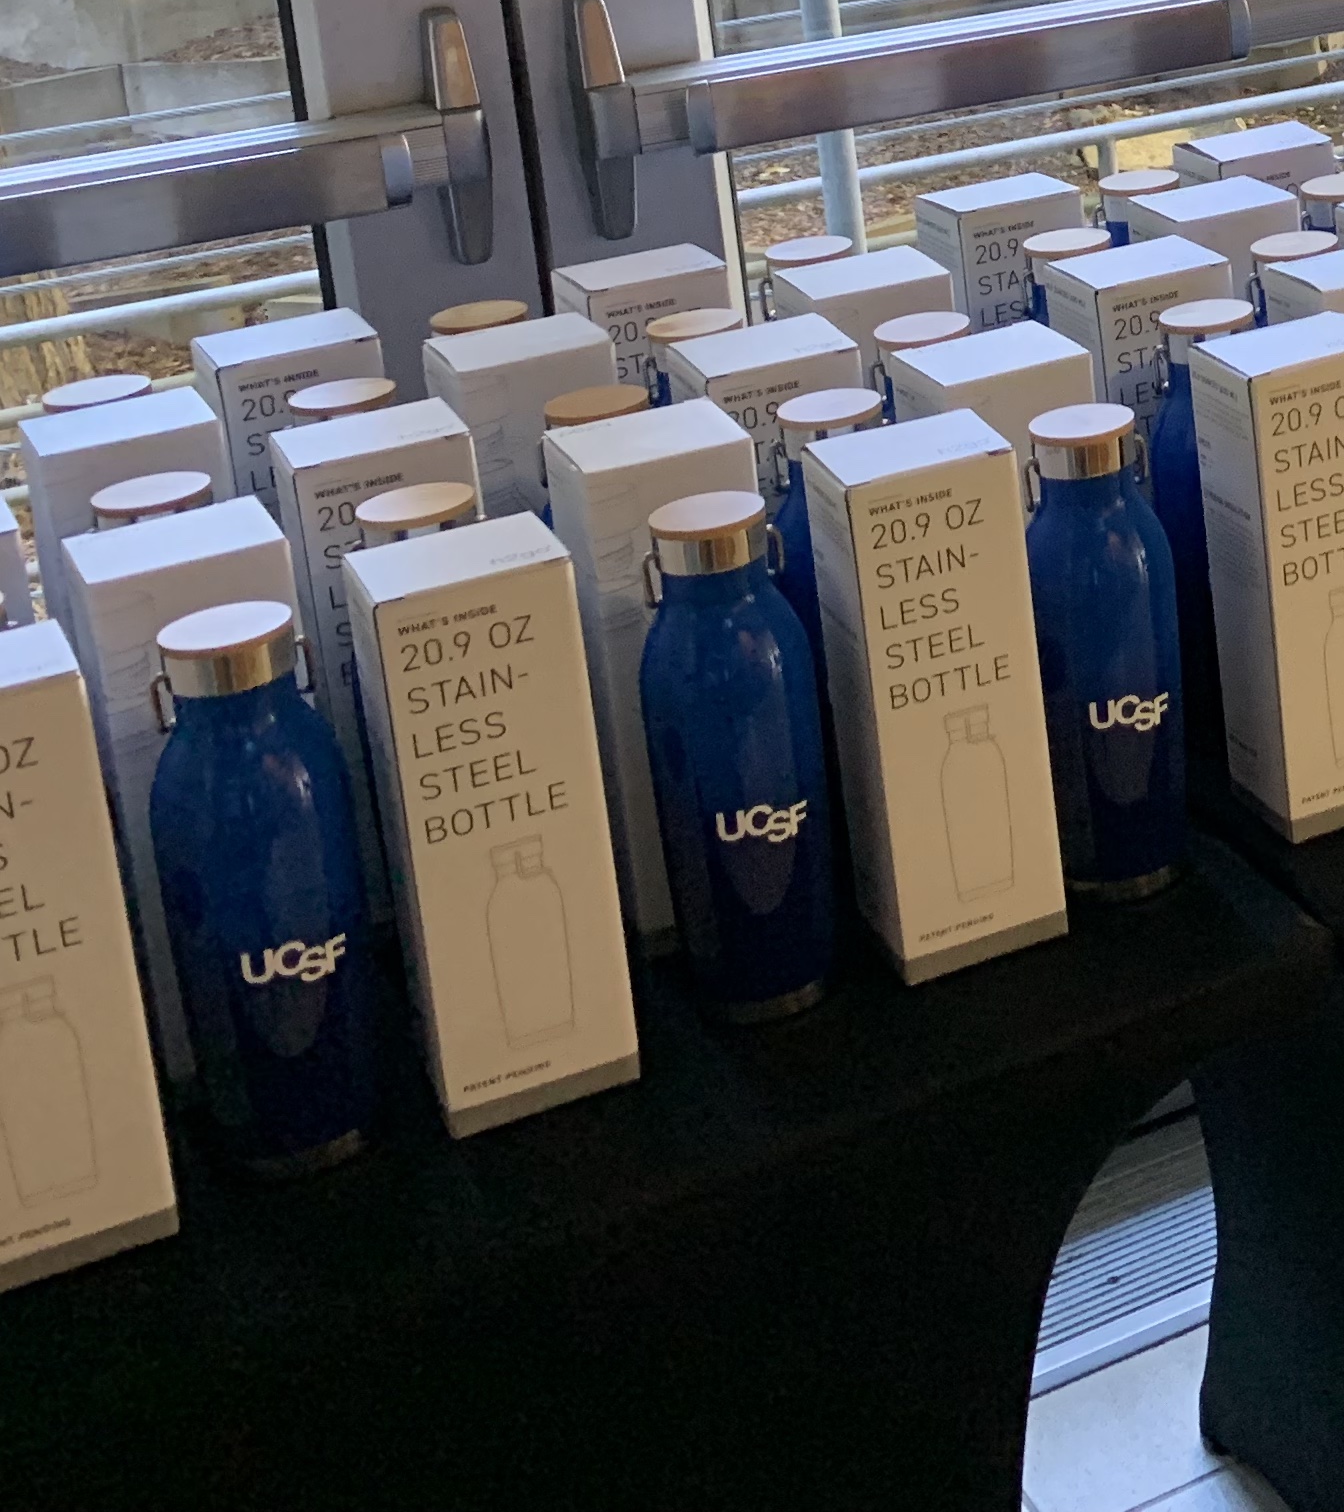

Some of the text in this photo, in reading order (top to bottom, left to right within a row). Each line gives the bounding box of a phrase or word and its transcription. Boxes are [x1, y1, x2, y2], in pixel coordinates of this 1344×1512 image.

[975, 238, 1019, 265] 20.9
[981, 300, 1024, 327] LES
[1112, 299, 1148, 313] WHAT'S
[283, 369, 320, 384] INSIDE
[1269, 380, 1342, 406] WHAT'S INSIDE
[1271, 402, 1322, 437] 20.9
[365, 472, 404, 489] INSIDE
[1276, 473, 1344, 512] LESS
[868, 488, 952, 516] WHAT'S INSIDE
[871, 498, 984, 550] 20.9 OZ
[876, 544, 979, 589] STAIN-
[398, 604, 498, 637] WHAT'S INSIDE
[880, 588, 960, 630] LESS
[401, 614, 534, 672] 20.9 OZ
[886, 624, 985, 670] STEEL
[407, 664, 529, 714] STAIN-
[890, 654, 1011, 710] BOTTLE
[1088, 692, 1169, 731] UCSF
[412, 711, 507, 759] LESS
[419, 750, 537, 801] STEEL
[424, 781, 569, 844] BOTTLE
[715, 800, 808, 843] UCSF
[240, 932, 346, 984] UCSF
